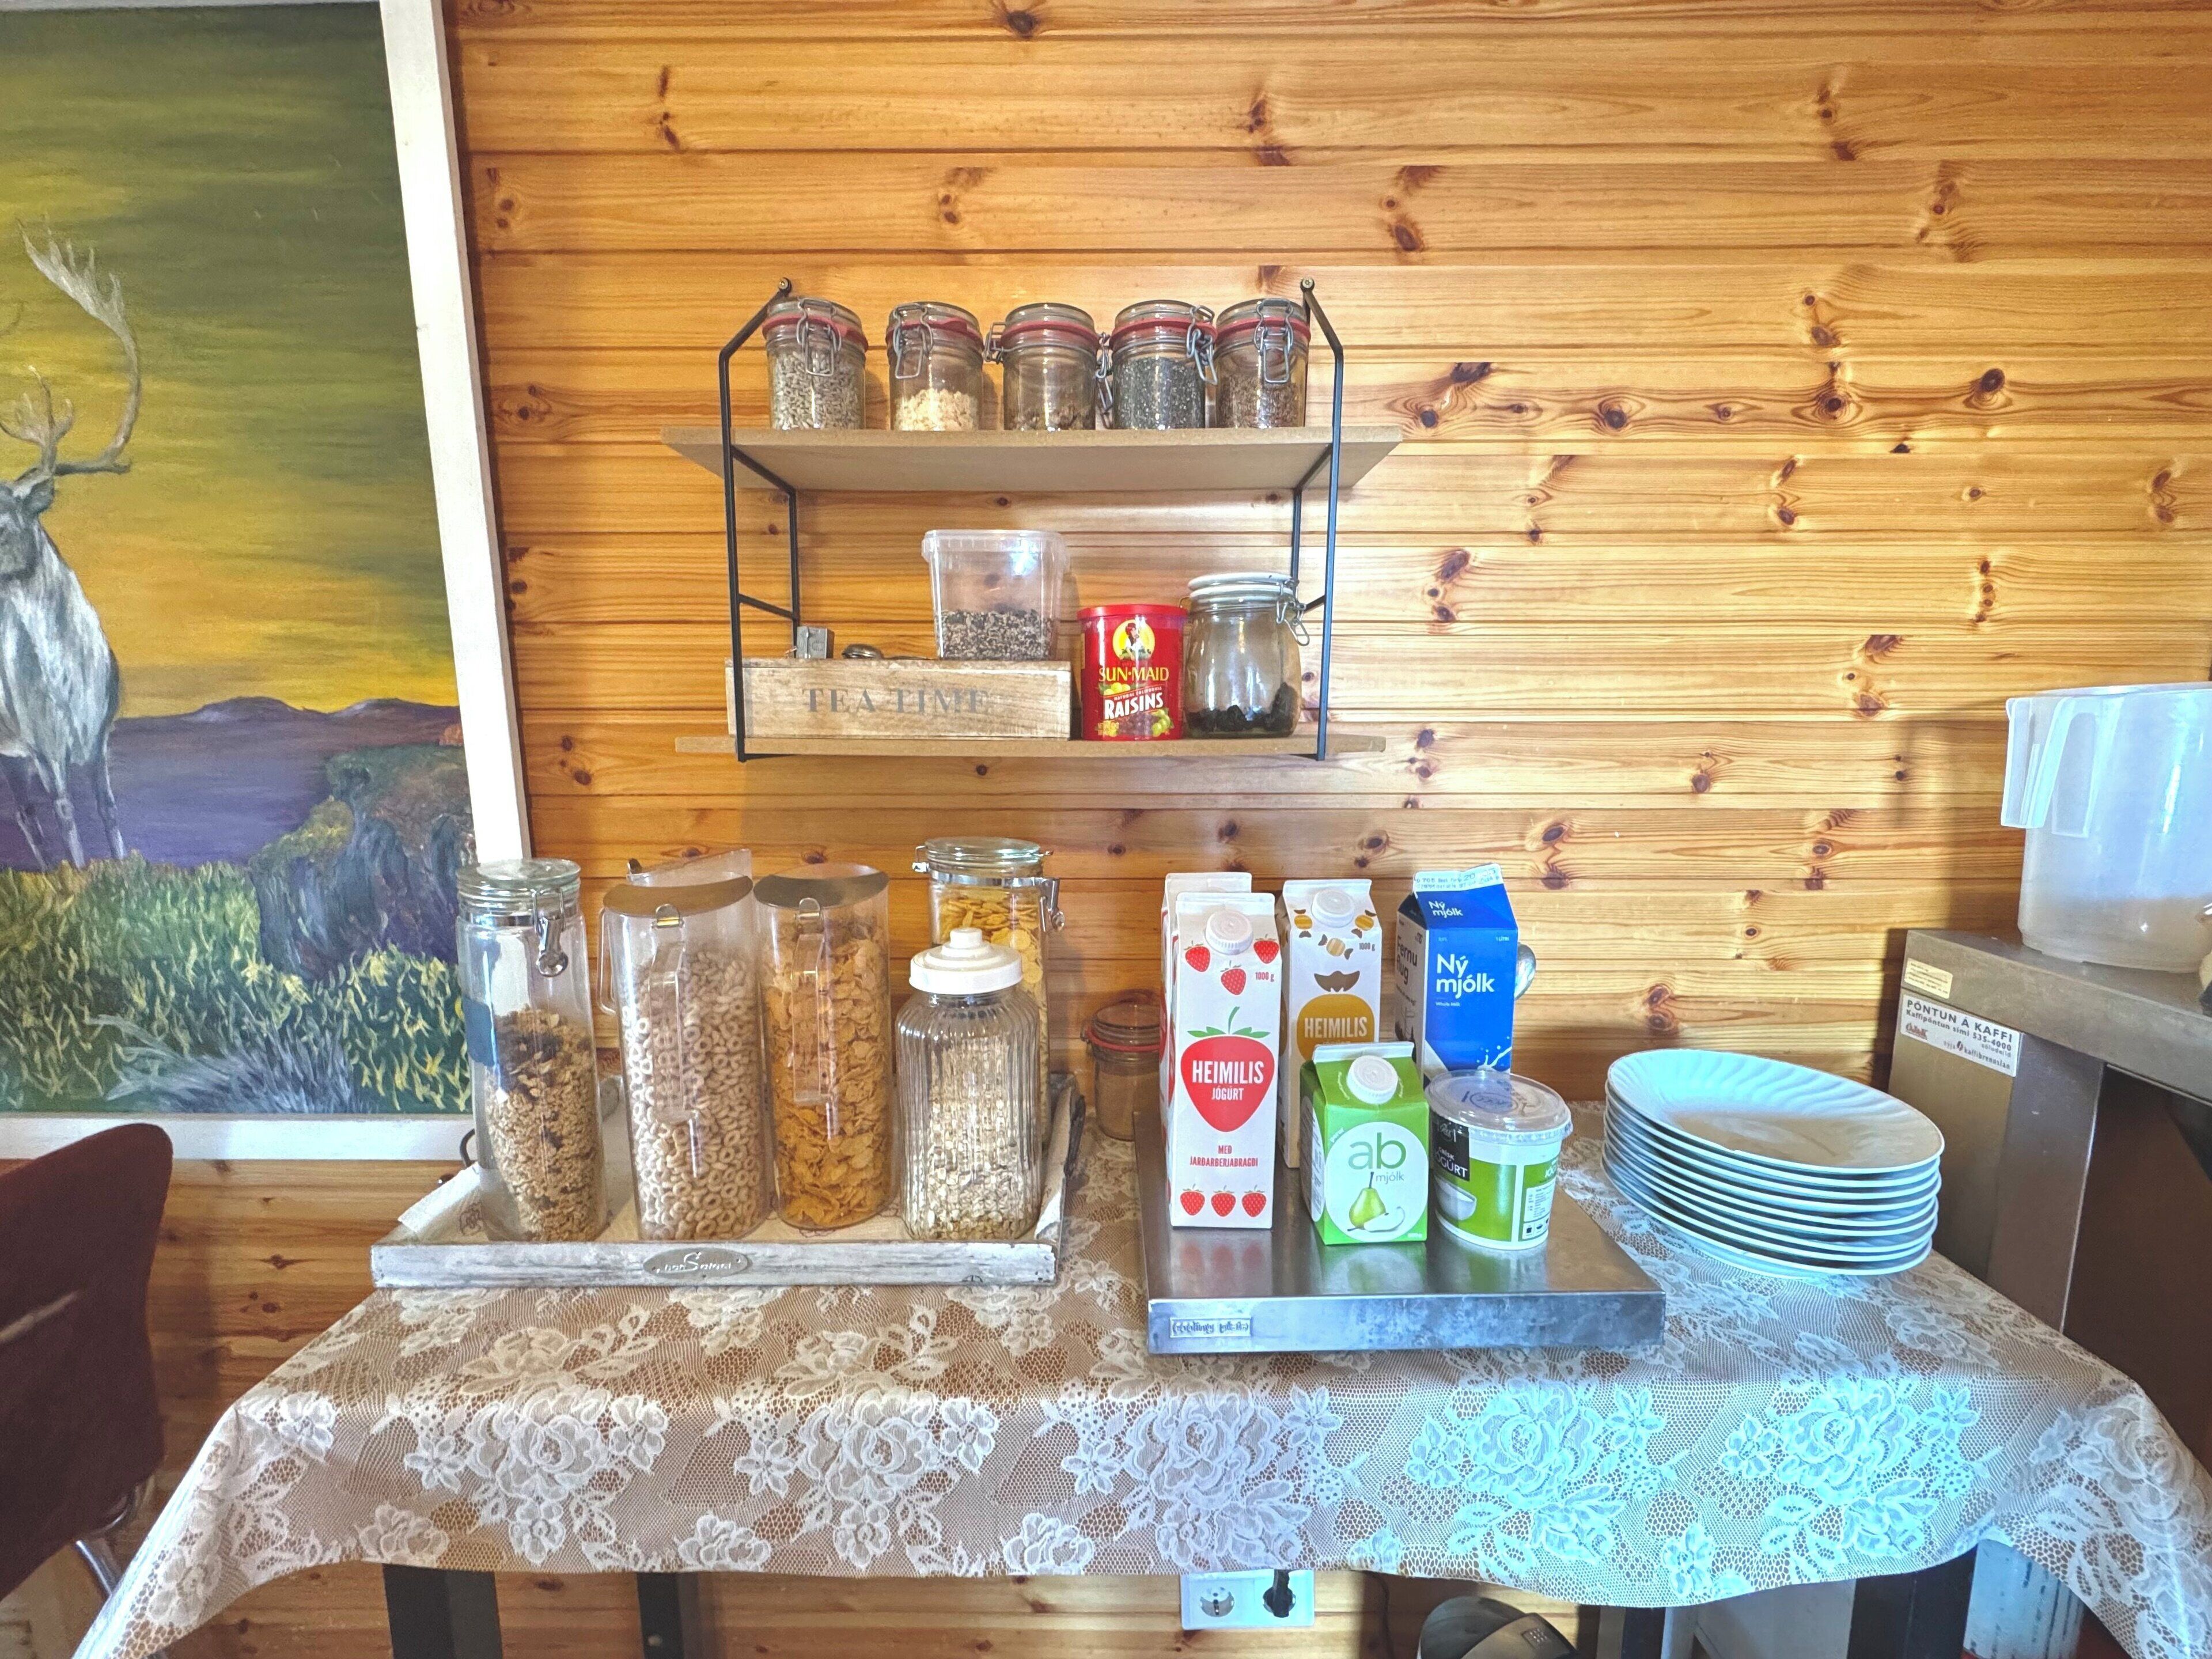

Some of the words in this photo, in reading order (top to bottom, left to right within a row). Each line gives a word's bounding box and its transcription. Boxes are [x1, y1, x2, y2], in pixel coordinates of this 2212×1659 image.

[802, 688, 876, 713] TEA
[893, 688, 988, 714] TIME
[1104, 692, 1164, 720] RAISINS
[1429, 900, 1445, 910] Ný
[1432, 908, 1463, 918] mjólk
[1255, 972, 1269, 980] 1000
[1270, 974, 1274, 982] g
[1437, 953, 1468, 979] Ný
[1436, 973, 1495, 999] mjólk
[1304, 1016, 1368, 1038] HEIMILIS
[1907, 999, 1957, 1024] PÖNTUN
[1975, 1022, 2012, 1043] KAFFI
[1972, 1032, 2012, 1051] 535-4000
[1192, 1060, 1264, 1084] HEIMILIS
[1211, 1085, 1244, 1101] JÓGÚRT
[1348, 1132, 1407, 1170] ab
[1376, 1171, 1405, 1185] mjólk
